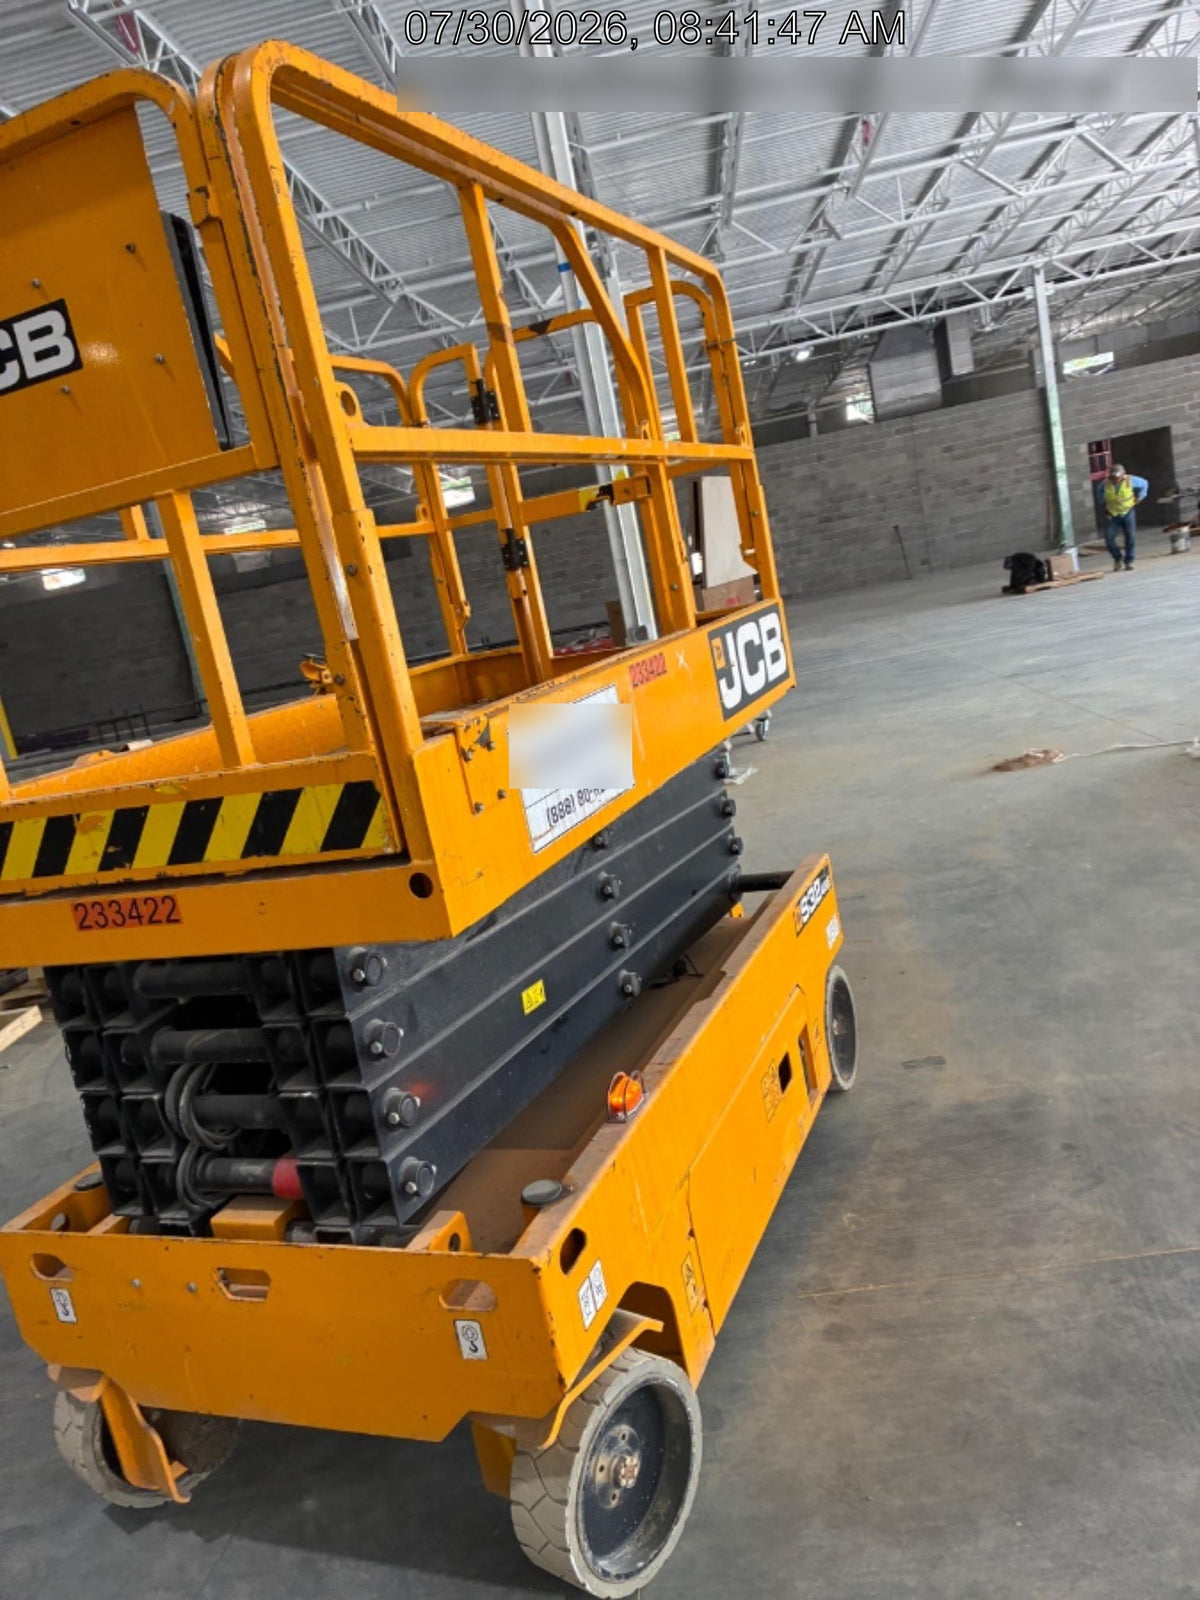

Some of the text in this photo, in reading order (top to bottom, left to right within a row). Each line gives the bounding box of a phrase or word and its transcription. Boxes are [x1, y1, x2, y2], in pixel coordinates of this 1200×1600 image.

[629, 652, 667, 688] 233422
[718, 612, 787, 709] JCB
[73, 895, 182, 930] 233422
